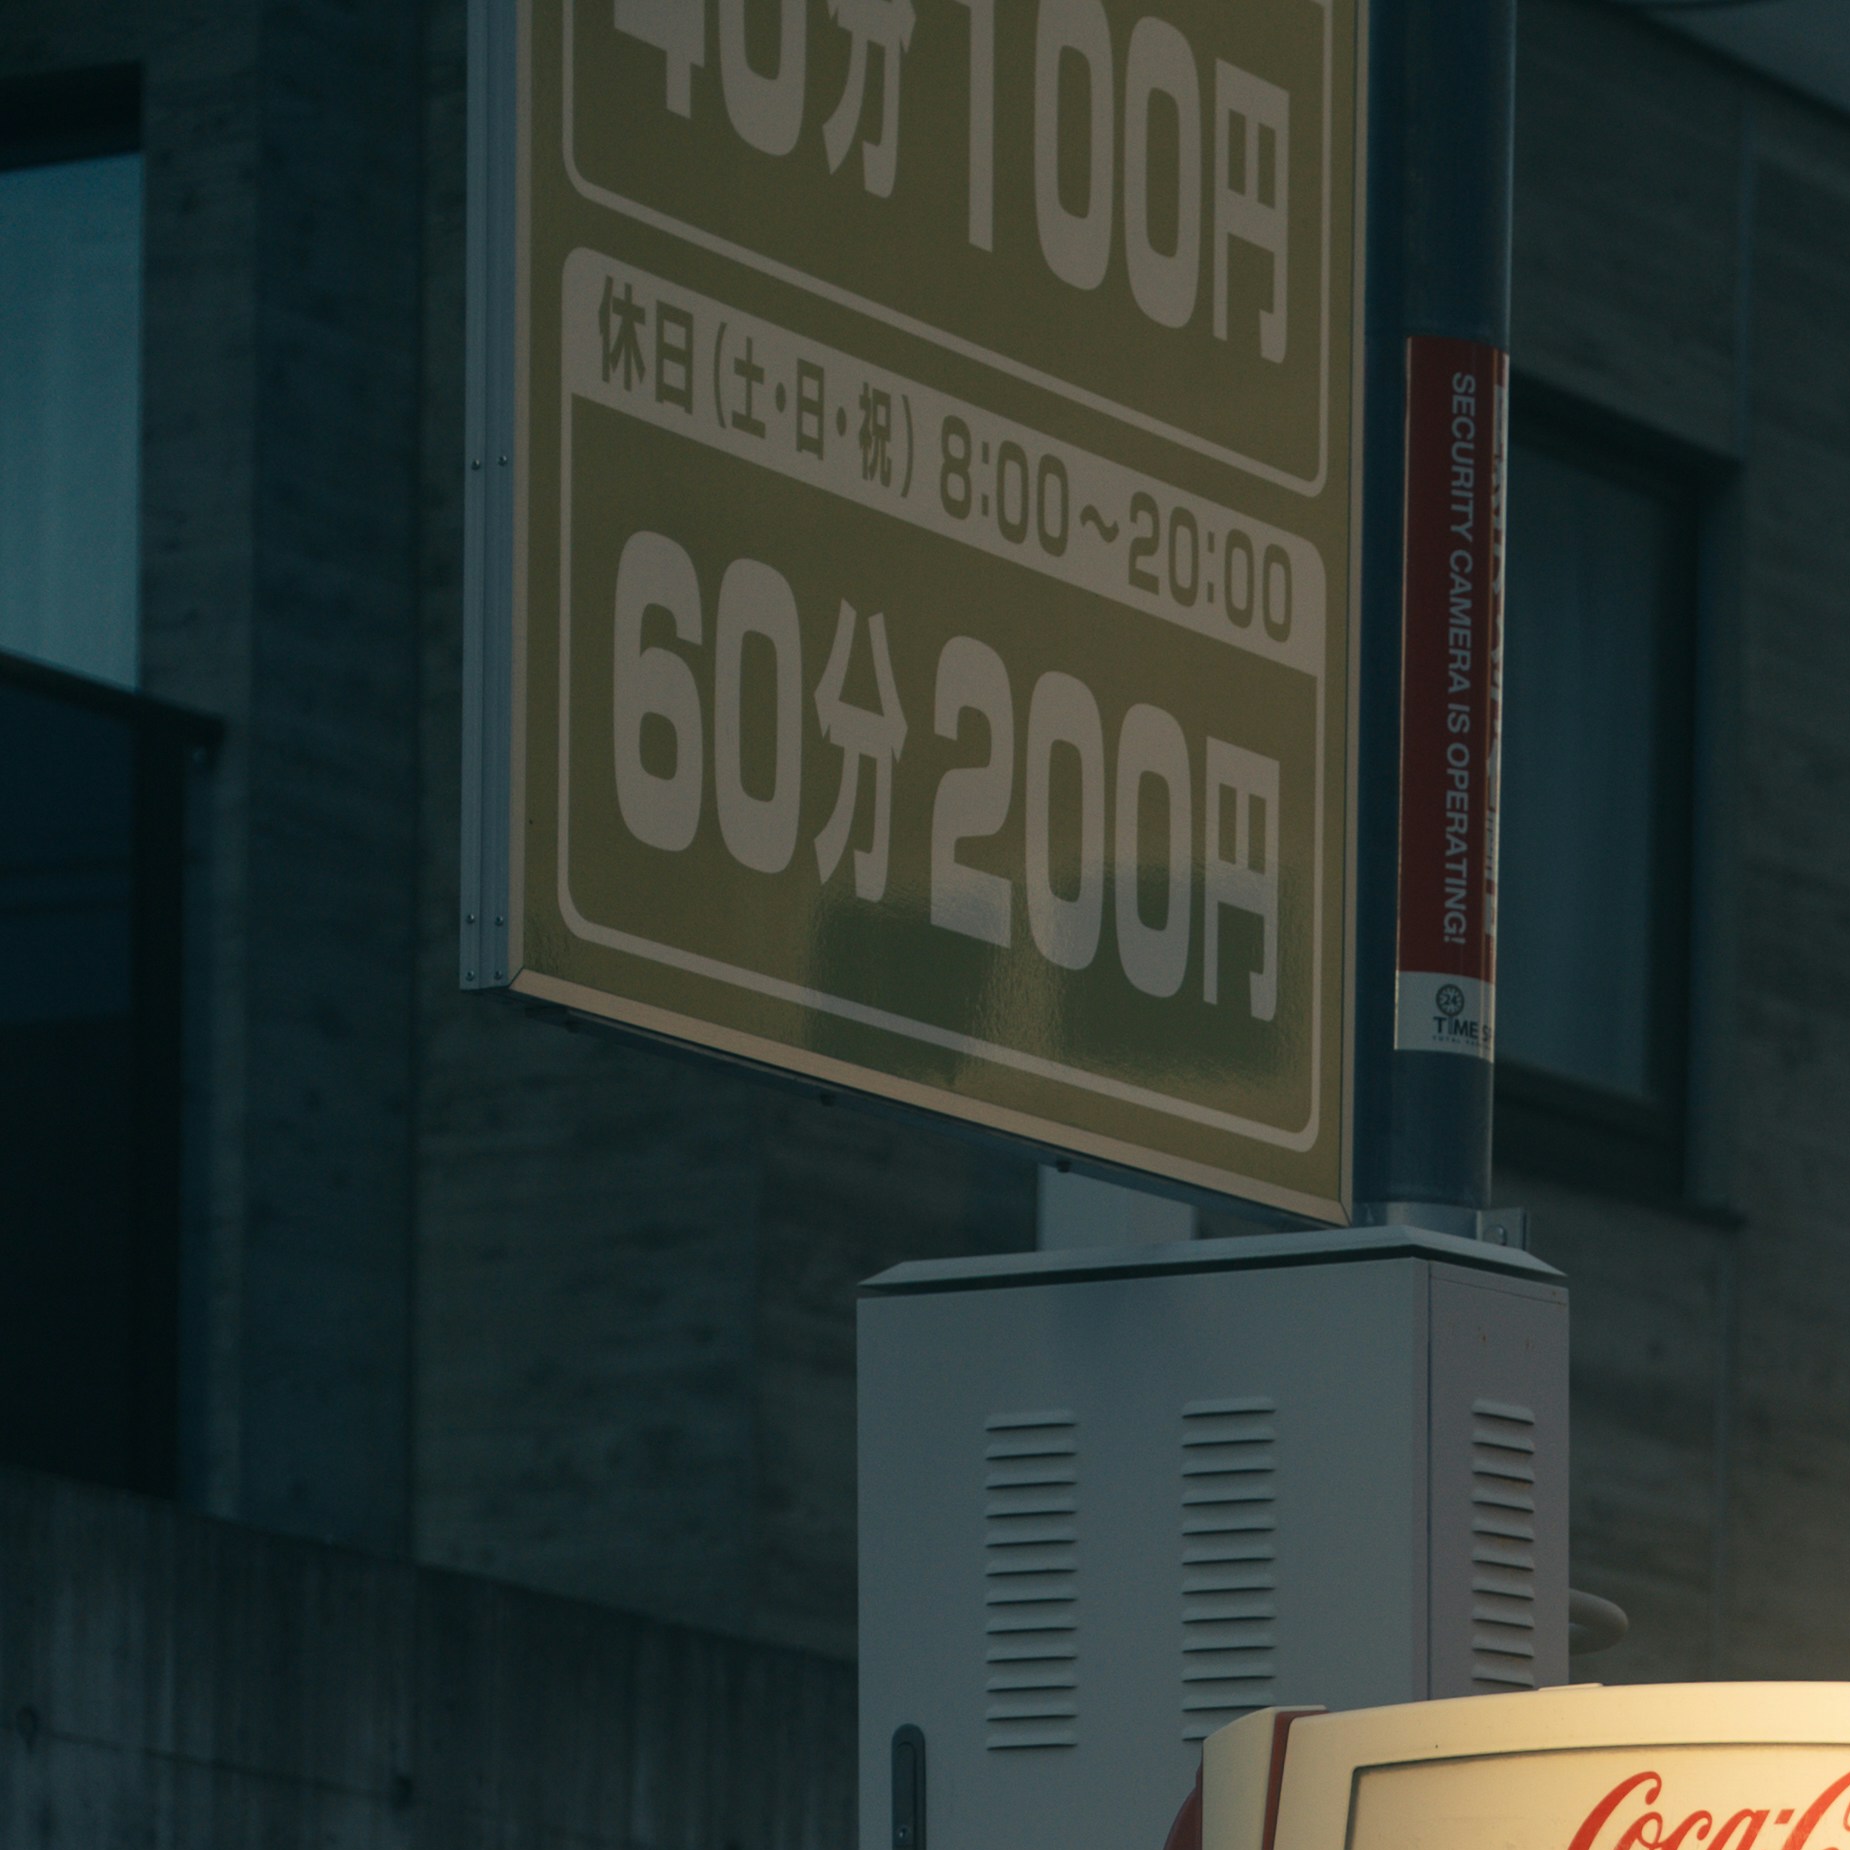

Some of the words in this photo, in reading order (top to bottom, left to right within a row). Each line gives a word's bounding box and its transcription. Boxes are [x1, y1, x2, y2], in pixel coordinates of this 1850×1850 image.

[1452, 372, 1476, 542] SECURITY
[1448, 550, 1472, 693] CAMERA
[614, 530, 1282, 1022] 60分200円
[1448, 705, 1470, 734] IS
[1444, 746, 1470, 944] OPERATING!
